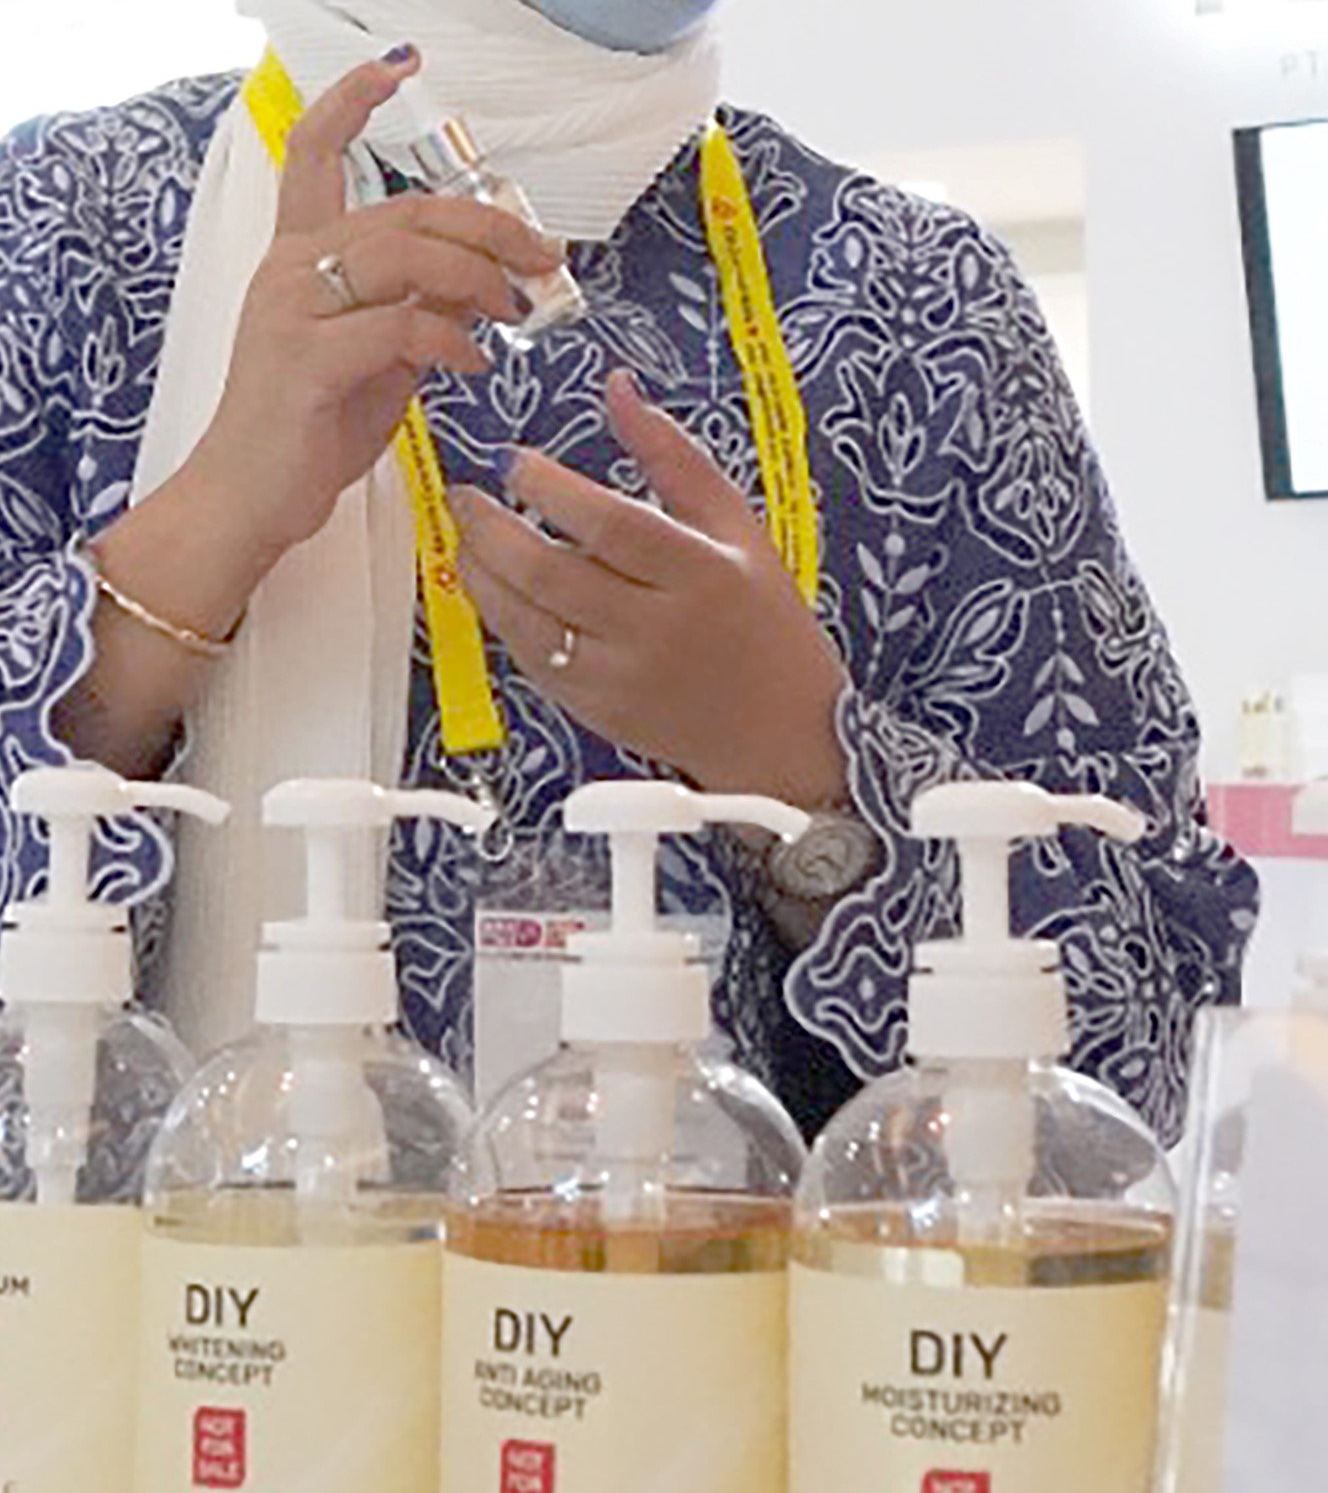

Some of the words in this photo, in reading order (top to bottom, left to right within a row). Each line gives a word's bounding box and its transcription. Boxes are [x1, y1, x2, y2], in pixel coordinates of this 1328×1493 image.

[185, 1283, 260, 1329] DIY
[167, 1334, 288, 1362] WHITENING
[494, 1307, 574, 1358] DIY
[174, 1356, 274, 1387] CONCEPT
[910, 1329, 1008, 1379] DIY
[522, 1366, 603, 1395] AGING
[478, 1384, 586, 1422] CONCEPT
[861, 1382, 1063, 1418] MOISTURIZING
[889, 1412, 1026, 1445] CONCEPT
